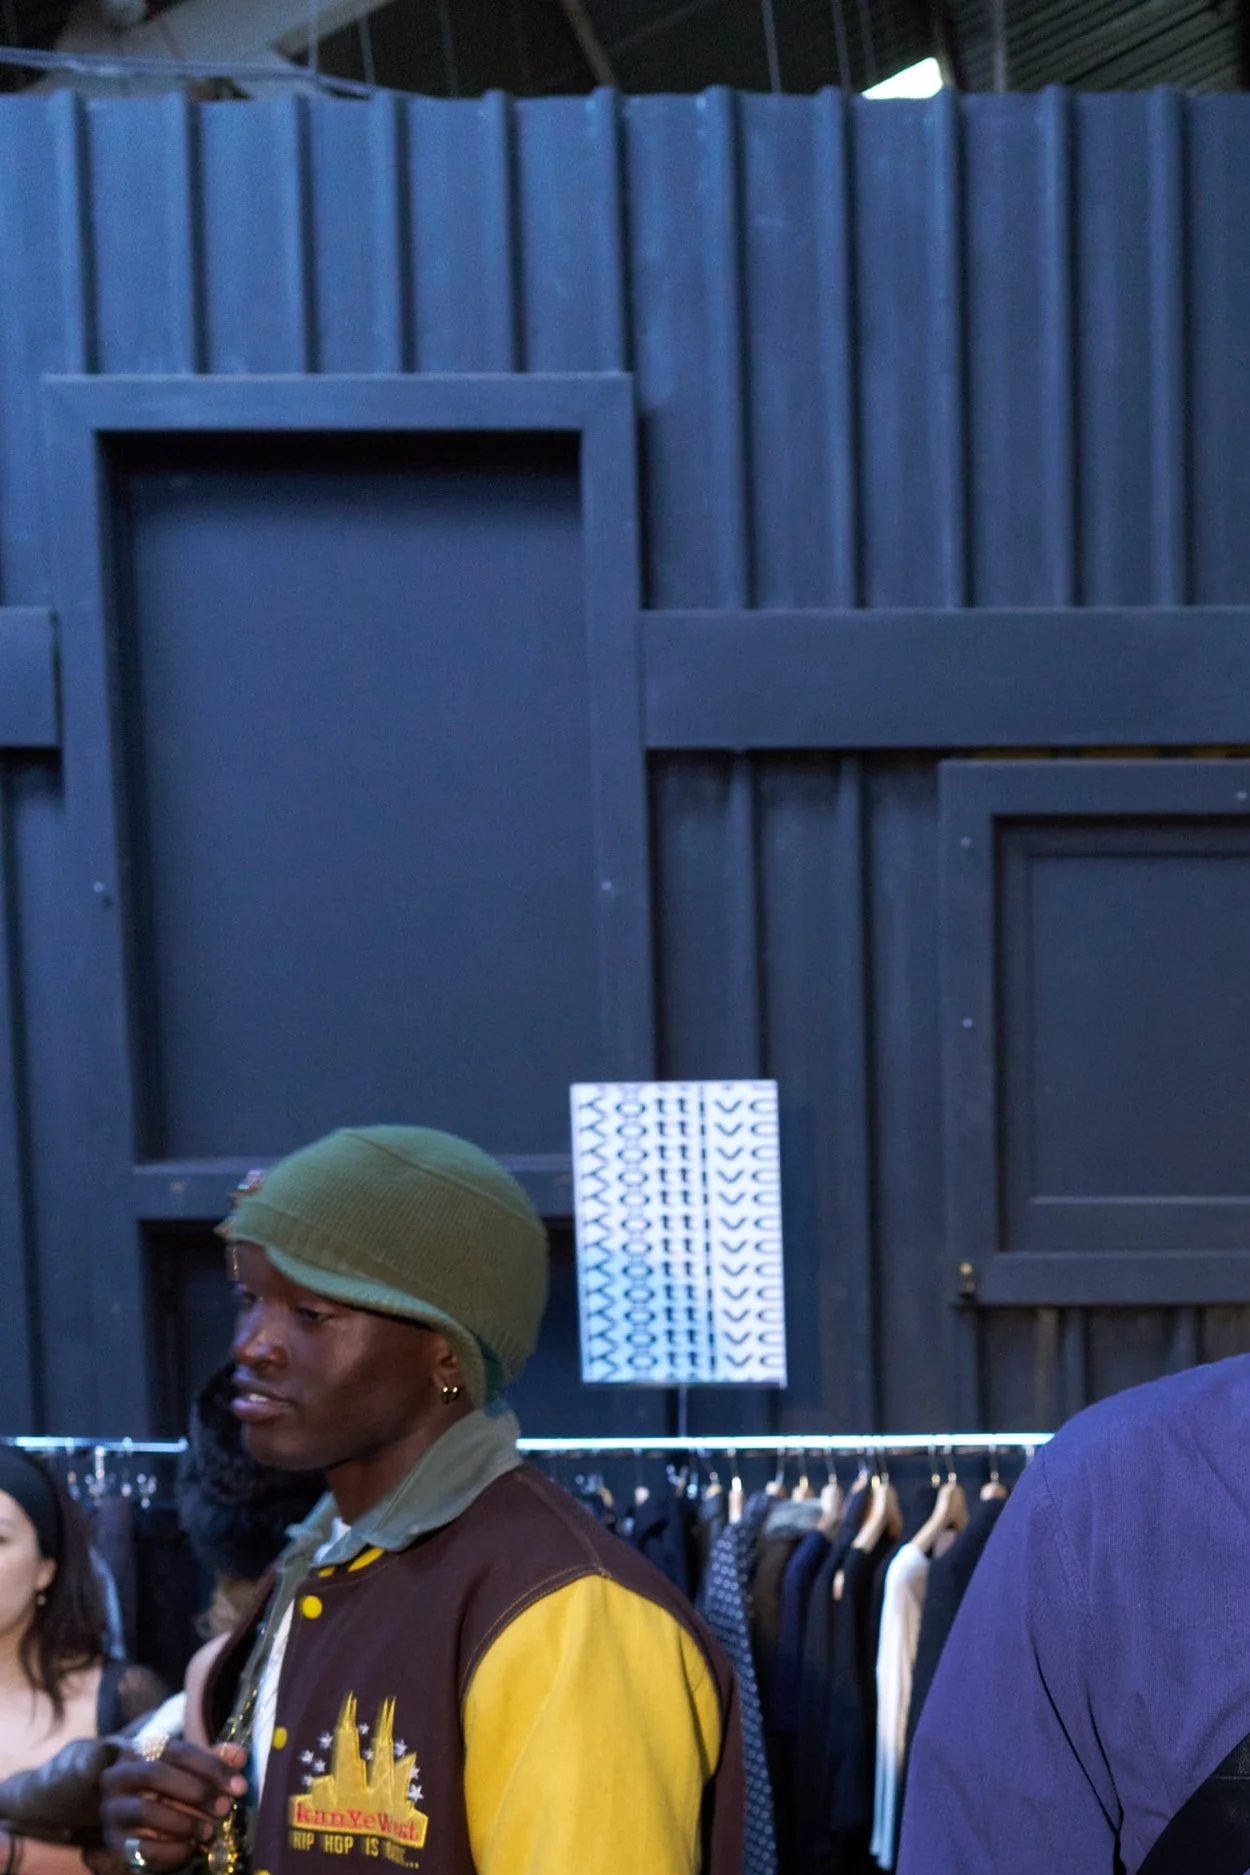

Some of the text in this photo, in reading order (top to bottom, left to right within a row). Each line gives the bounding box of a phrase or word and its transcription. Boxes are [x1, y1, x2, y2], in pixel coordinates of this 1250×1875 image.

[293, 1831, 314, 1850] HIP
[324, 1834, 354, 1855] HOP
[366, 1837, 379, 1857] IS
